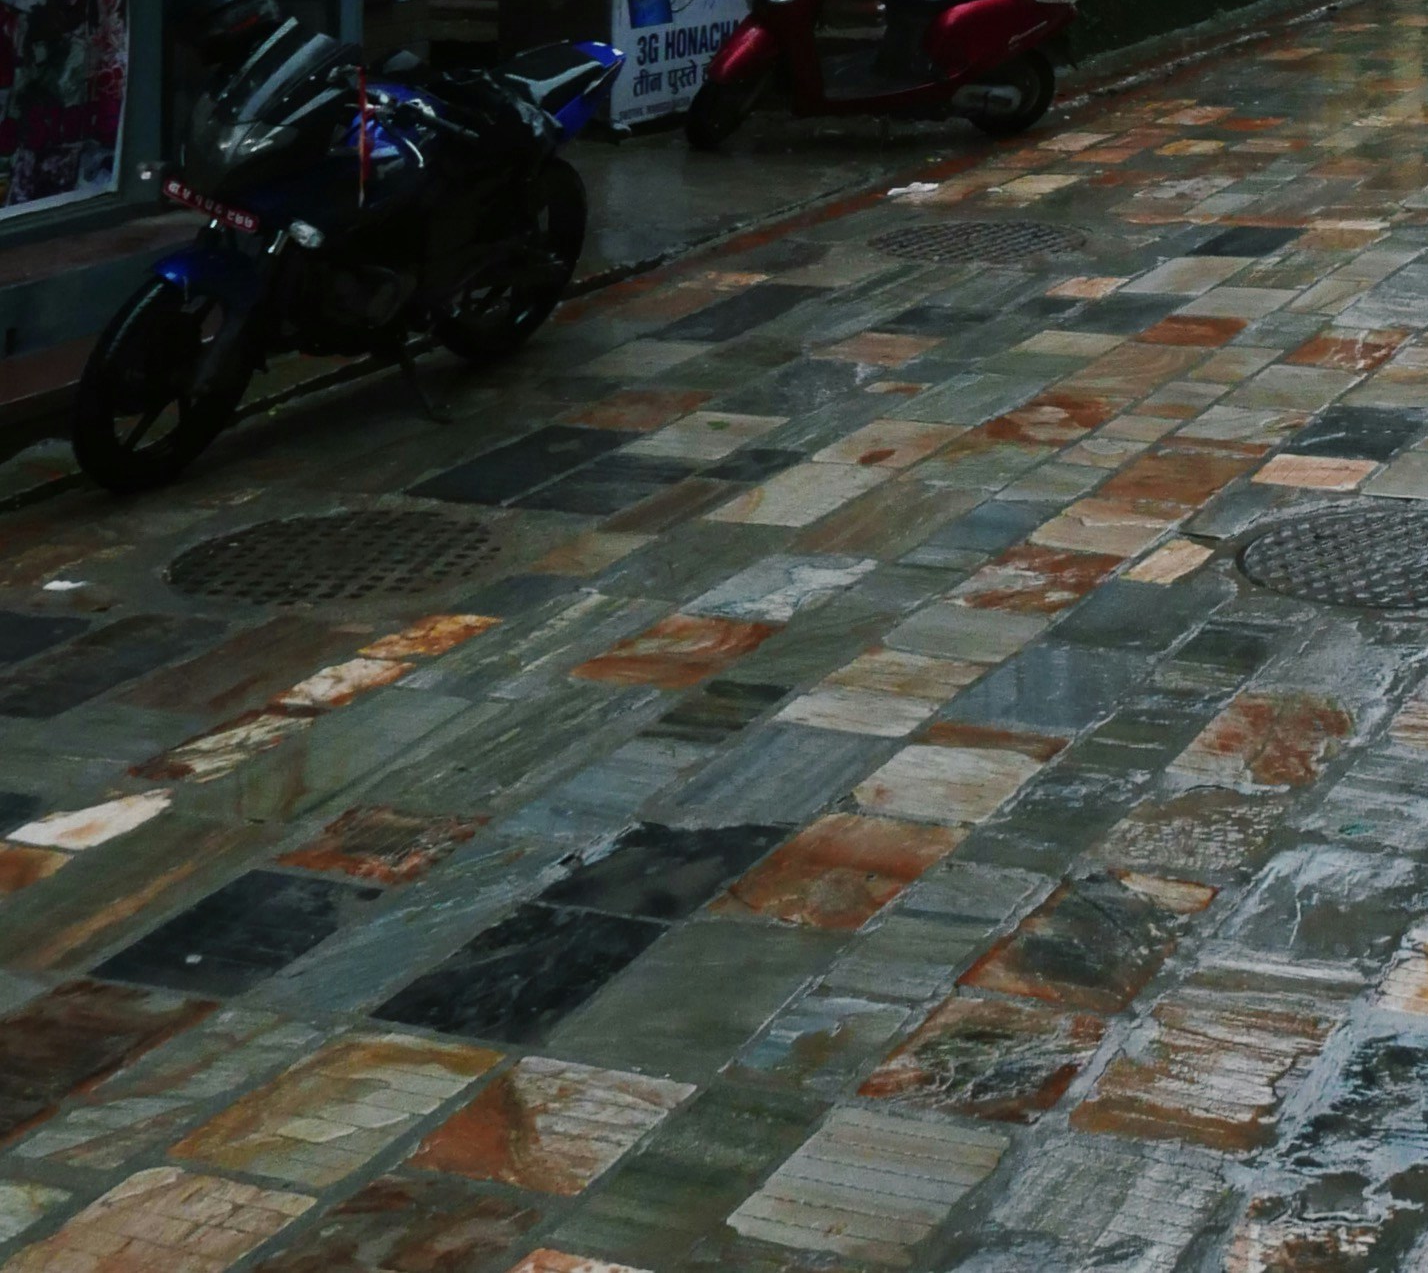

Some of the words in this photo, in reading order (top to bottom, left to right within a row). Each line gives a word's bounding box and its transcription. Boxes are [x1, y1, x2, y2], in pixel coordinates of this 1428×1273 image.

[637, 33, 660, 66] 3G
[665, 19, 740, 61] HONACH
[633, 67, 662, 98] तीन
